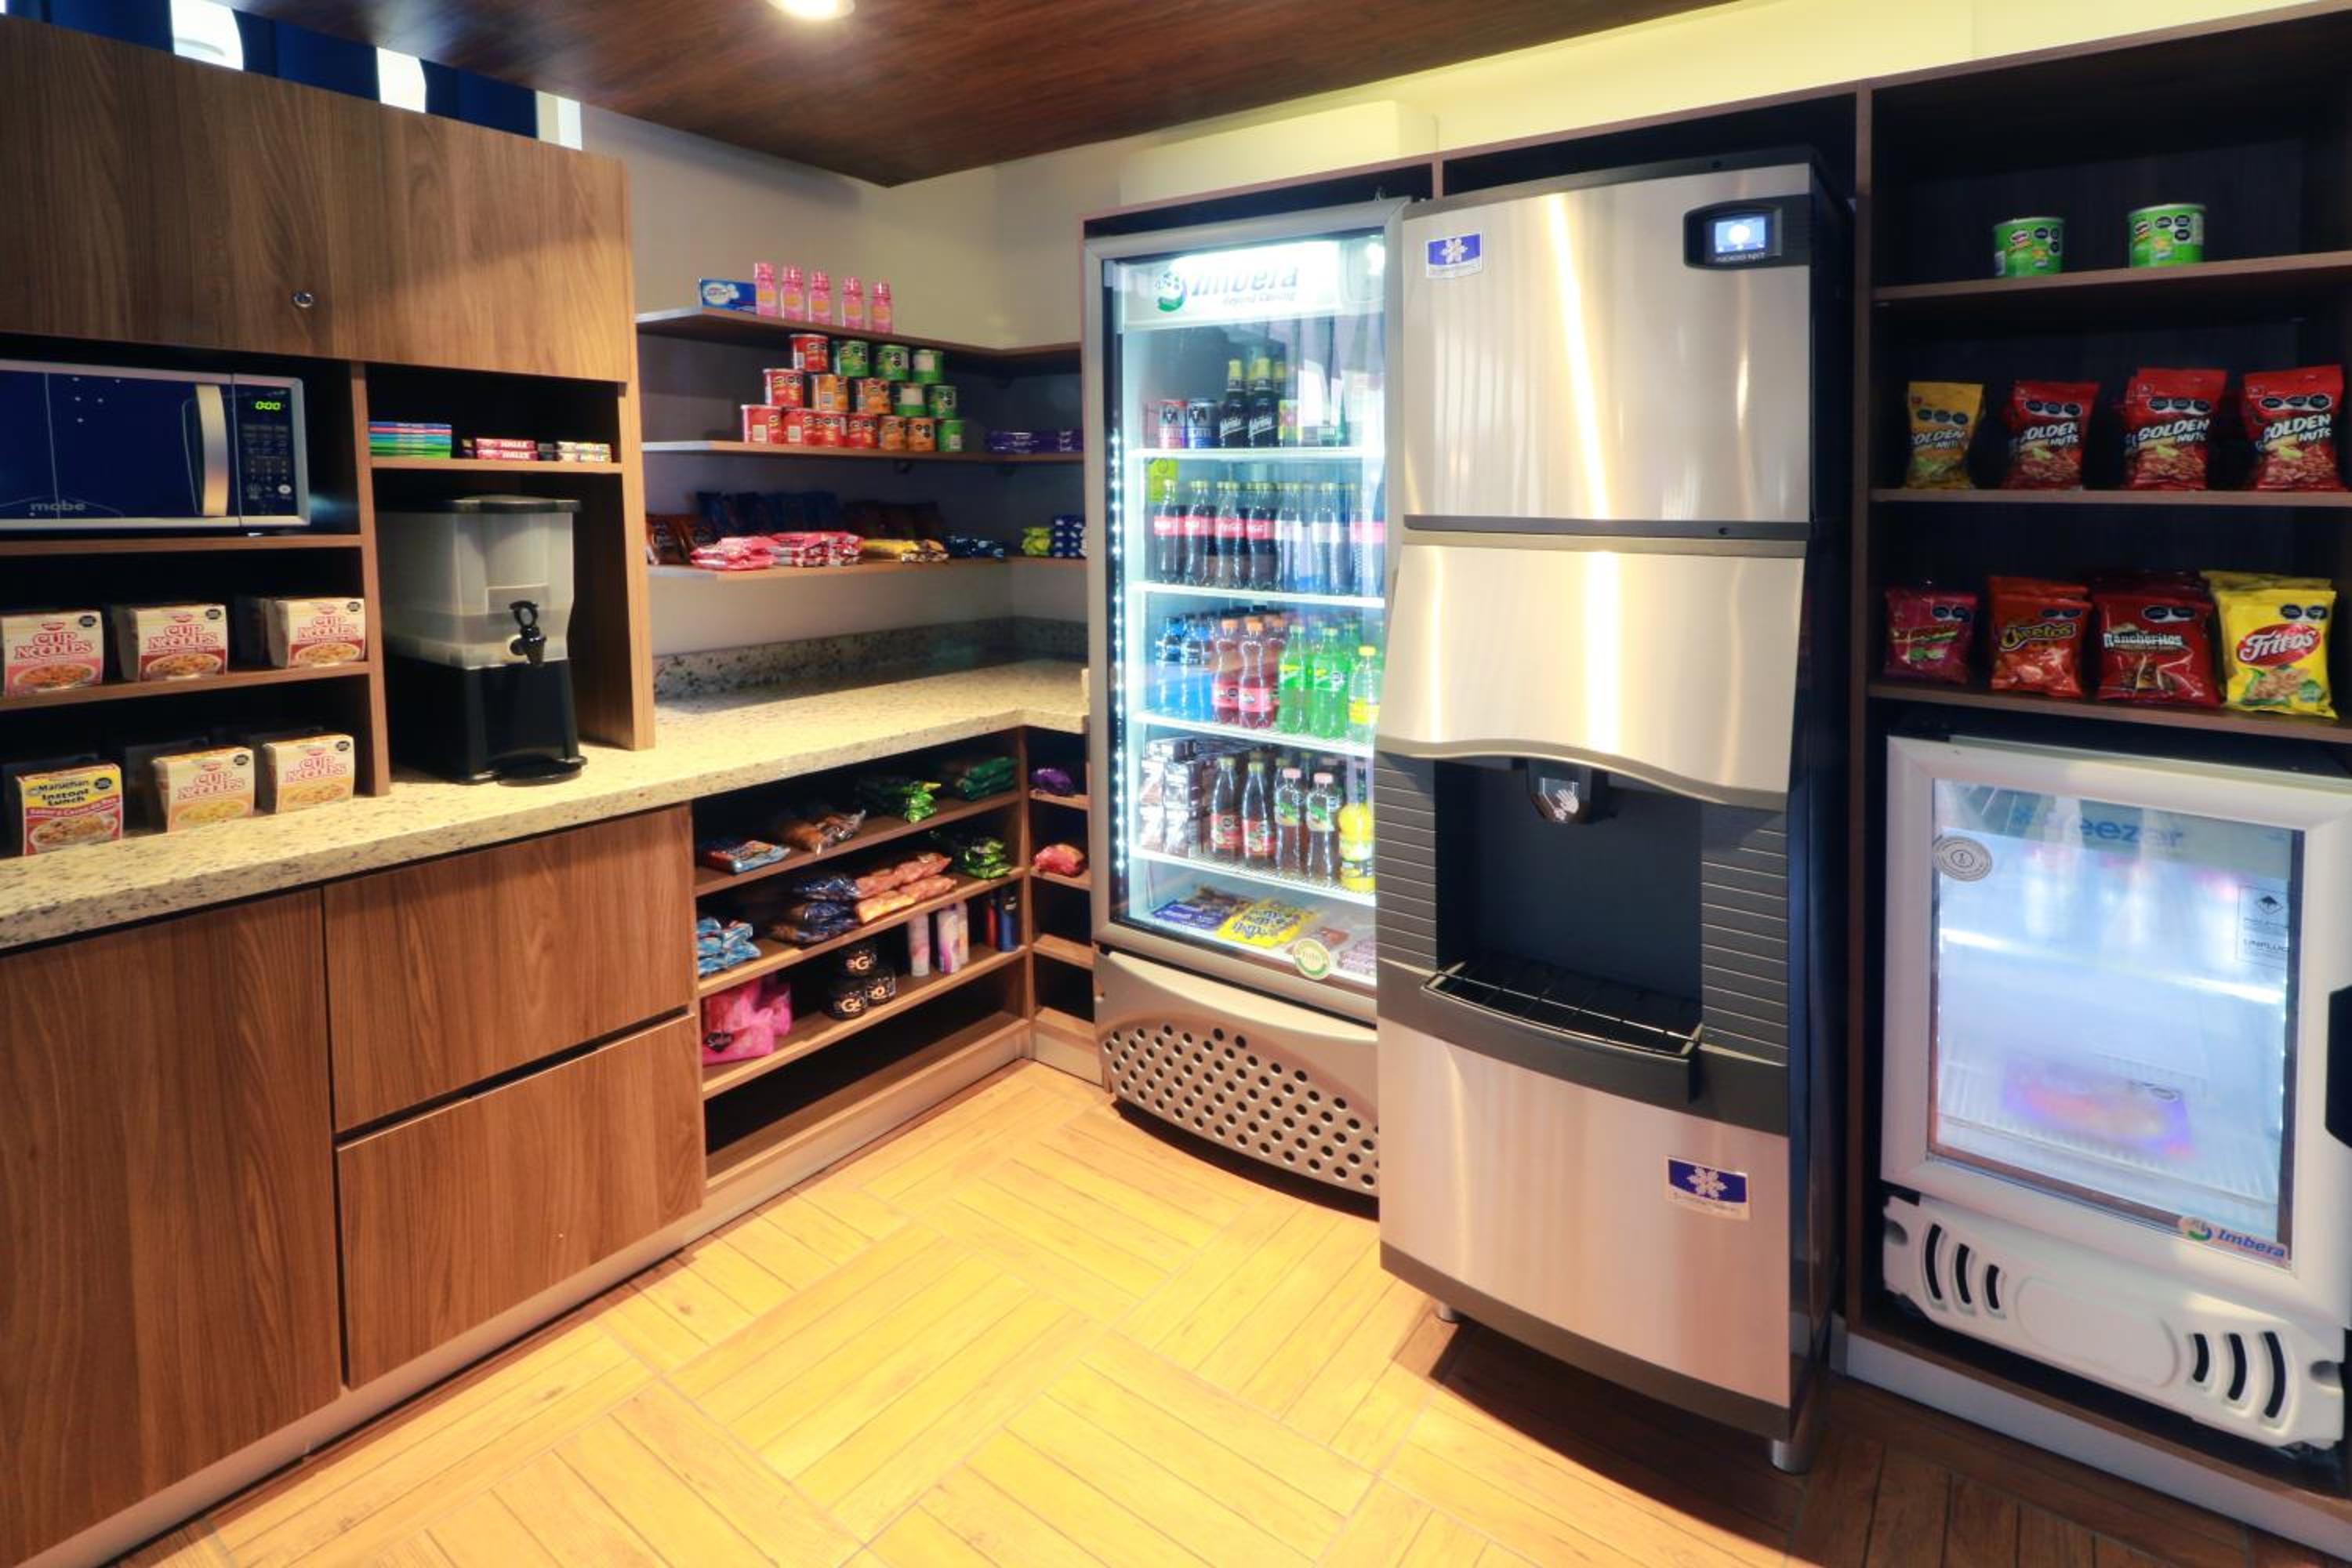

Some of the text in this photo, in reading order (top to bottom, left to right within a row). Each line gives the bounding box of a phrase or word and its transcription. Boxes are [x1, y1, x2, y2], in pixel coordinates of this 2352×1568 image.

[1911, 426, 1966, 446] OLDEN
[2020, 422, 2079, 442] OLDEN
[2137, 418, 2211, 441] GOLDEN
[2298, 427, 2332, 441] NUTS
[2049, 434, 2079, 446] NUTS
[2176, 432, 2207, 444] NUTS
[30, 500, 86, 511] mabe
[312, 615, 346, 627] CUP
[164, 624, 204, 637] CUP
[297, 623, 358, 639] NOODLES
[33, 632, 78, 647] CUP
[149, 633, 218, 650] NOODLES
[2103, 632, 2183, 649] Rancheritos
[2238, 630, 2318, 662] Fritos
[14, 641, 93, 659] NOODLES
[42, 788, 89, 800] Instant
[48, 796, 85, 806] Lunch
[2219, 1228, 2285, 1258] Imbera
